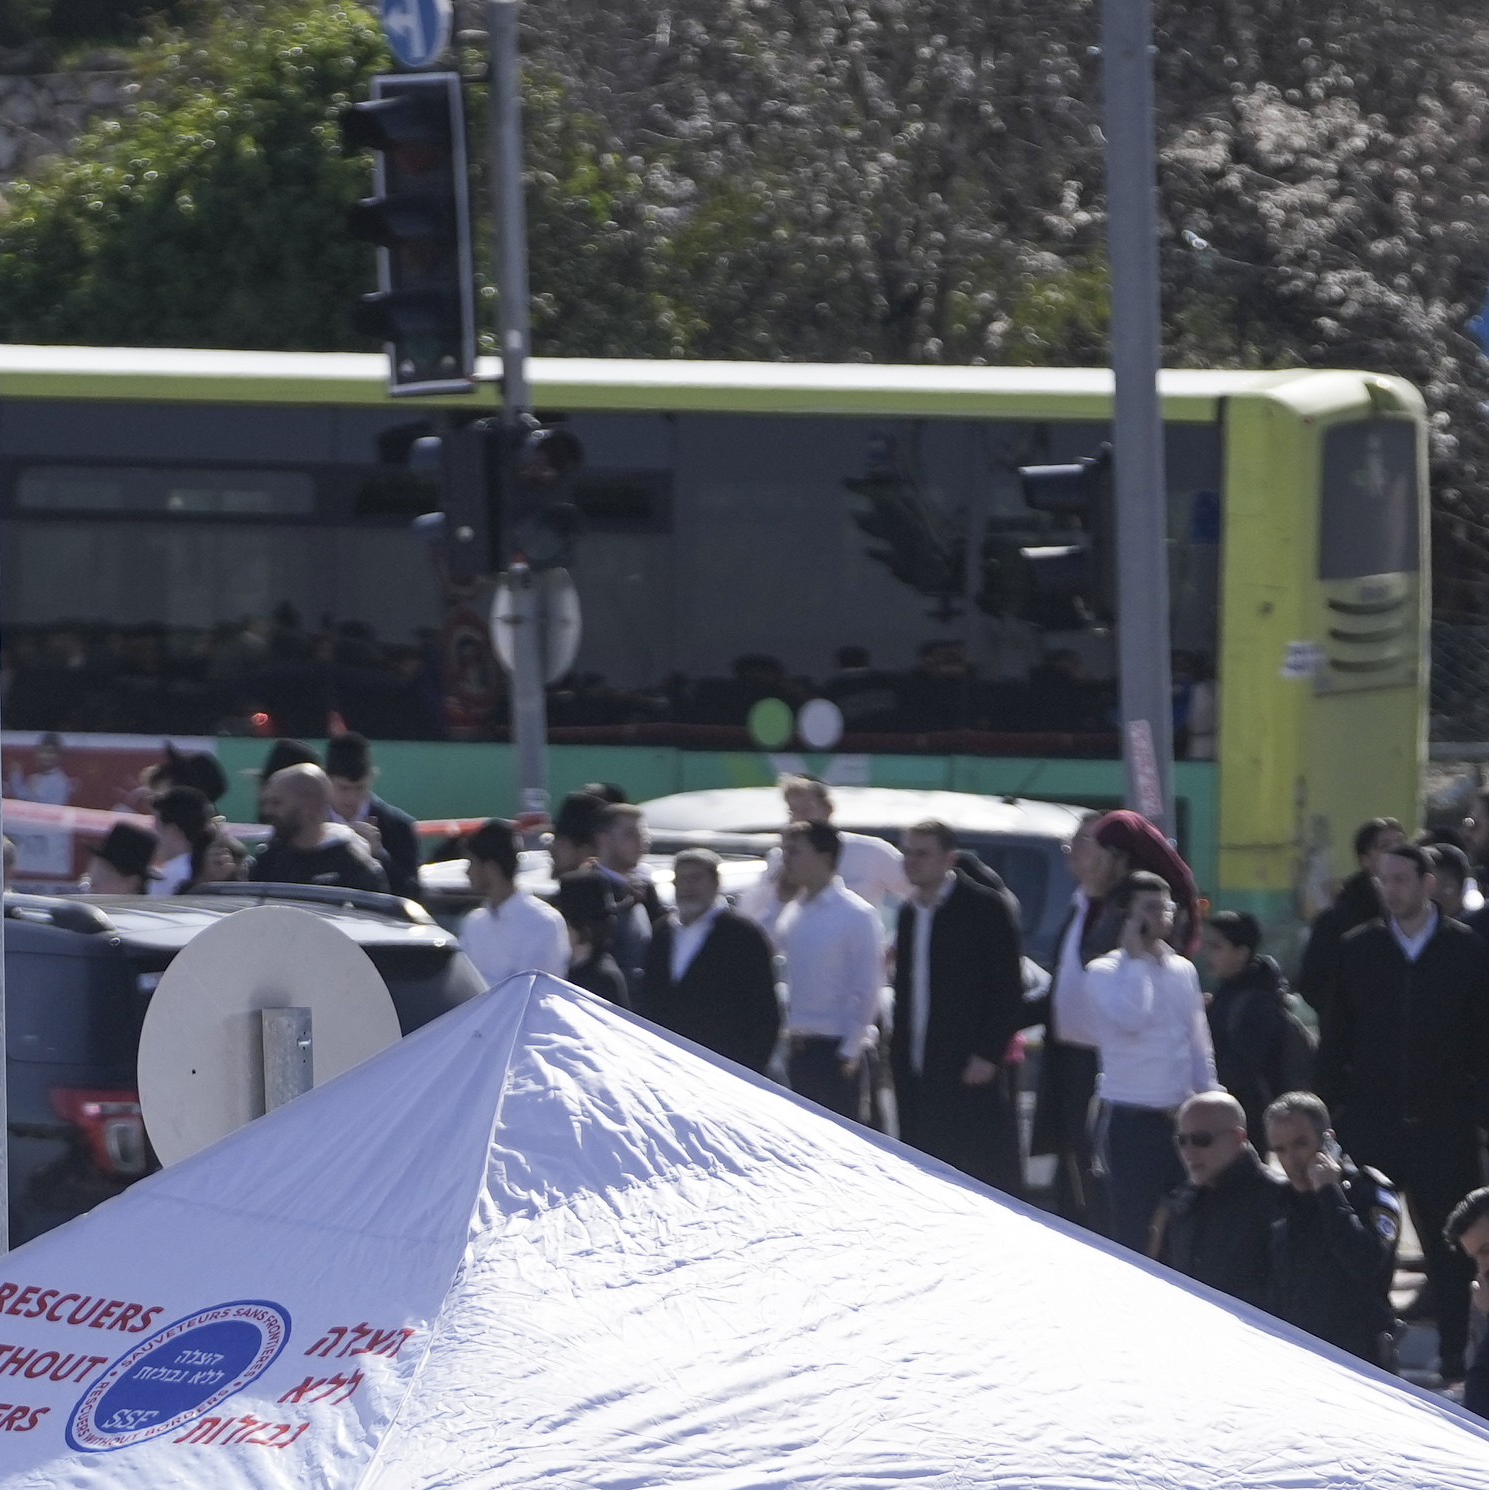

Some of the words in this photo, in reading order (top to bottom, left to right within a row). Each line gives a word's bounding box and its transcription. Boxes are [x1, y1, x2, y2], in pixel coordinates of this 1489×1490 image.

[121, 1308, 231, 1367] SAUVETEURS
[232, 1306, 268, 1321] SANS
[304, 1322, 417, 1359] הצלה
[133, 1365, 184, 1383] גבולות
[174, 1349, 224, 1365] הצלה
[188, 1370, 225, 1385] ללא
[277, 1368, 365, 1405] ללא
[76, 1381, 109, 1438] RESCUERS
[102, 1408, 160, 1430] SSF
[144, 1389, 230, 1436] BORDERS
[83, 1432, 139, 1446] WITHOUT
[172, 1413, 310, 1449] גבולות
